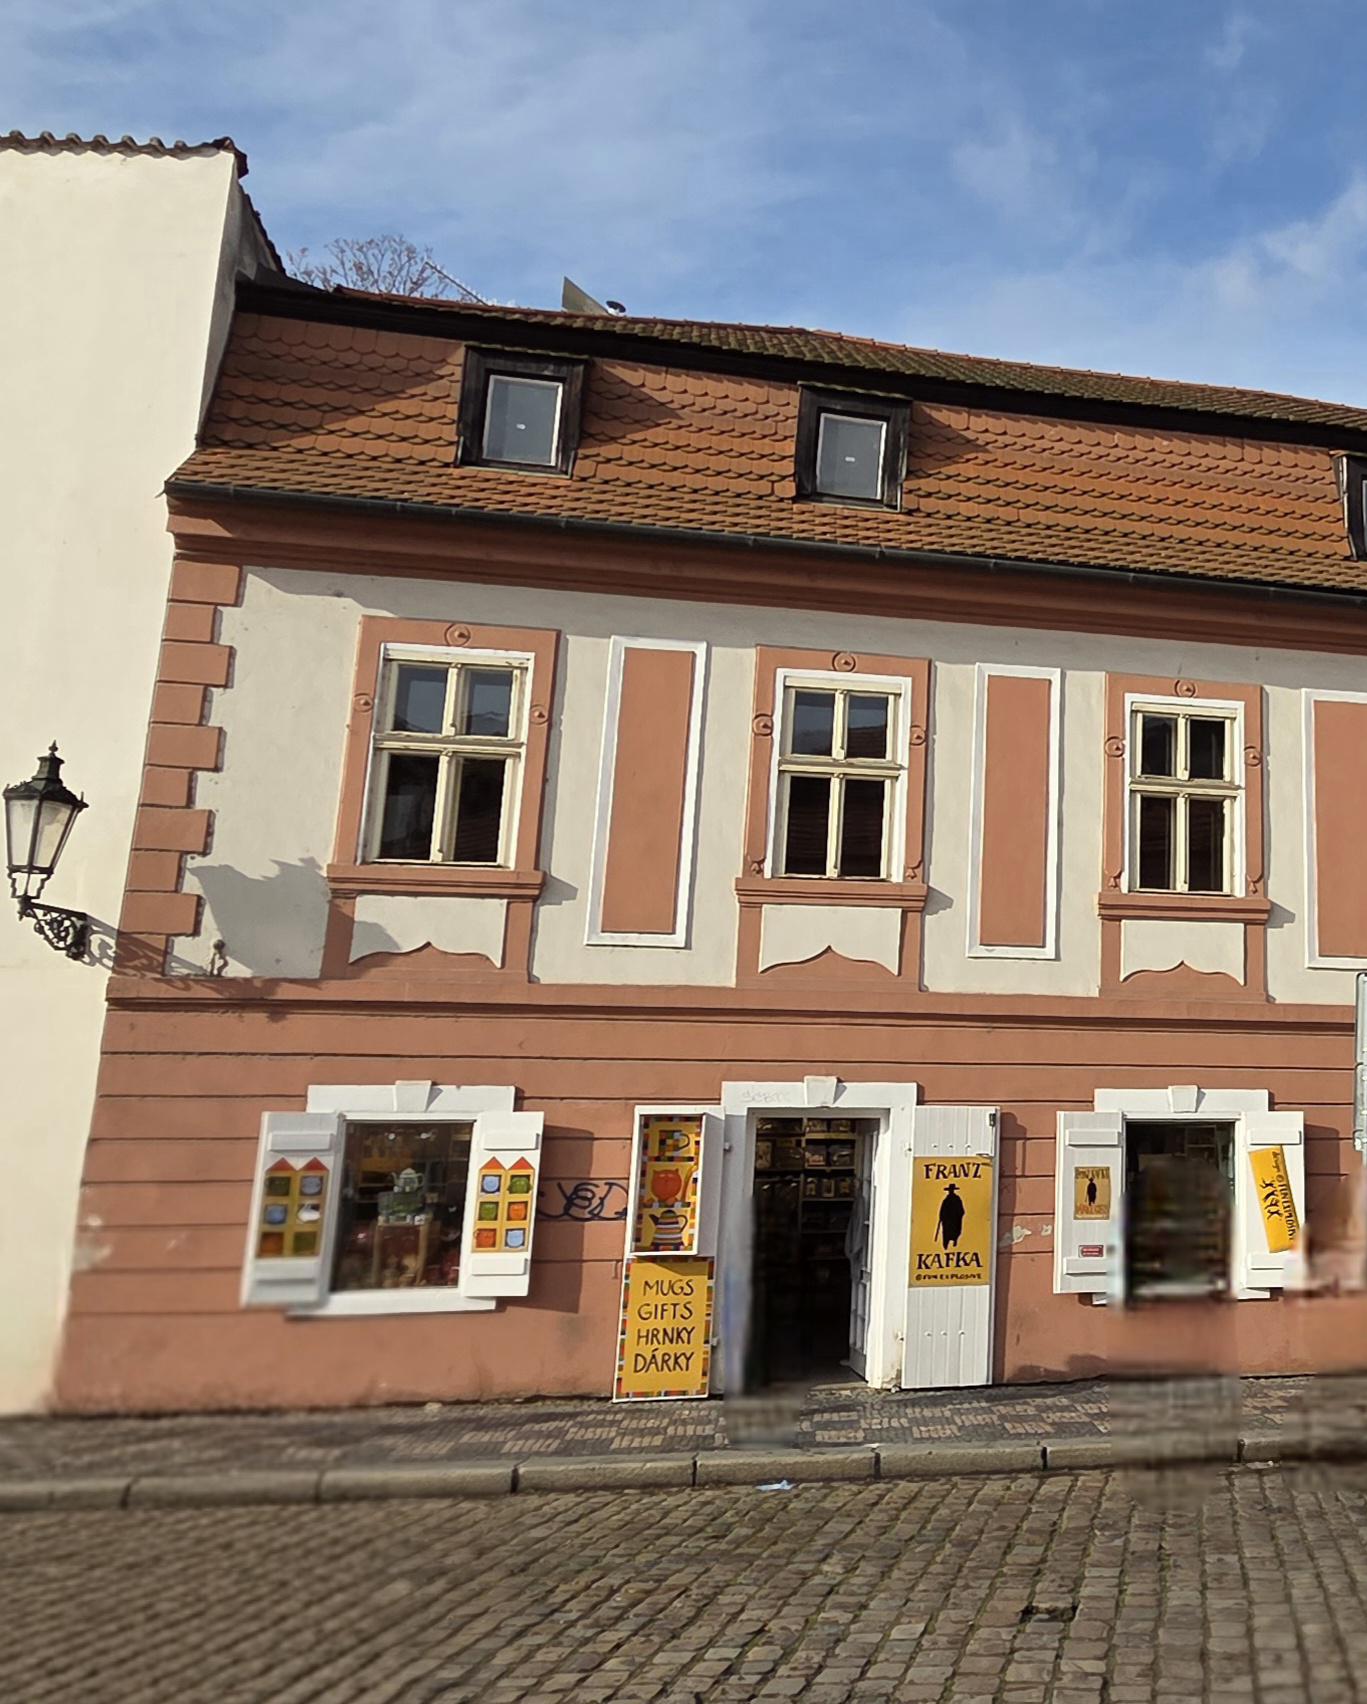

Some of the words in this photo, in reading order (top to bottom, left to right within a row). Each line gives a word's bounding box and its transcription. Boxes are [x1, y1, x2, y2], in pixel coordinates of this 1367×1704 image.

[924, 1162, 981, 1180] FRANZ
[916, 1252, 983, 1270] KAFKA
[643, 1279, 694, 1296] MUGS
[637, 1301, 693, 1320] GIFTS
[636, 1326, 695, 1346] HRNKY
[633, 1348, 694, 1373] DÁRKY
